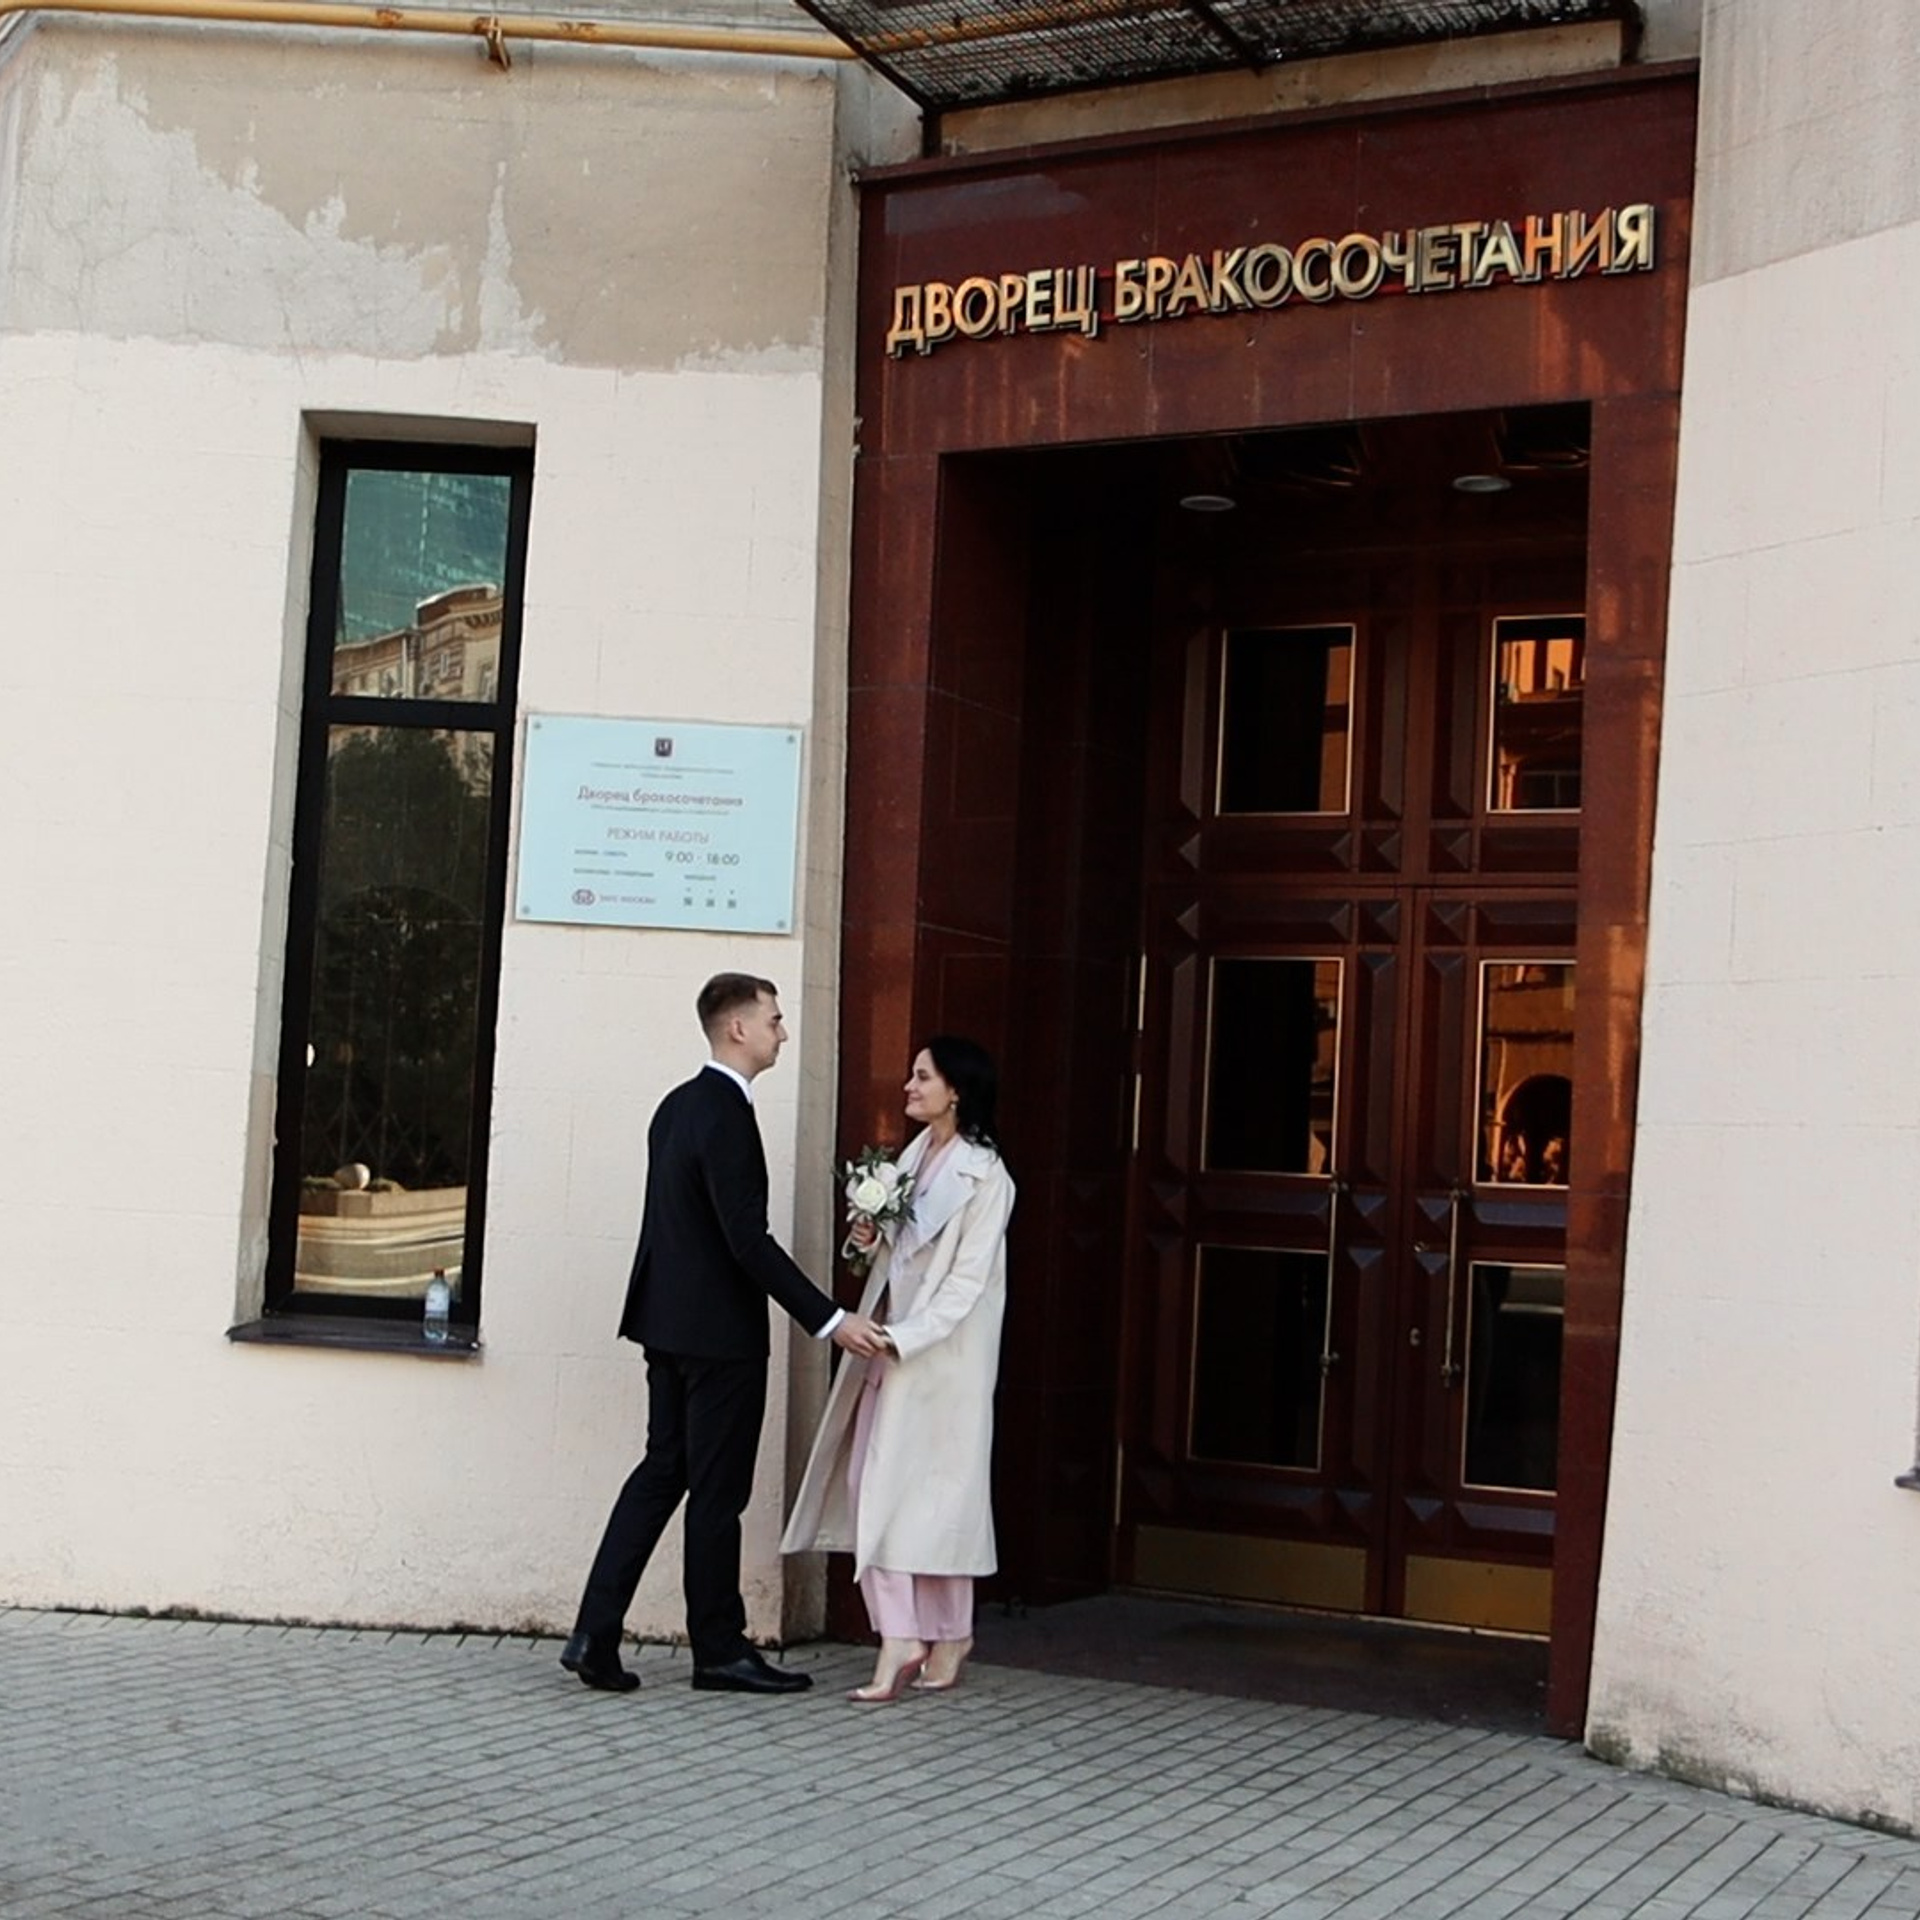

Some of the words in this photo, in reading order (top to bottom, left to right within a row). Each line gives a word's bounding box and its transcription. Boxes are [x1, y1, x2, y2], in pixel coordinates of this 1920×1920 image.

[886, 265, 1098, 358] ДВОРЕЦ
[1113, 204, 1655, 323] БРАКОСОЧЕТАНИЯ
[577, 785, 630, 803] Дворец
[607, 827, 655, 842] РЕЖИМ
[659, 830, 709, 846] РАБОТЫ
